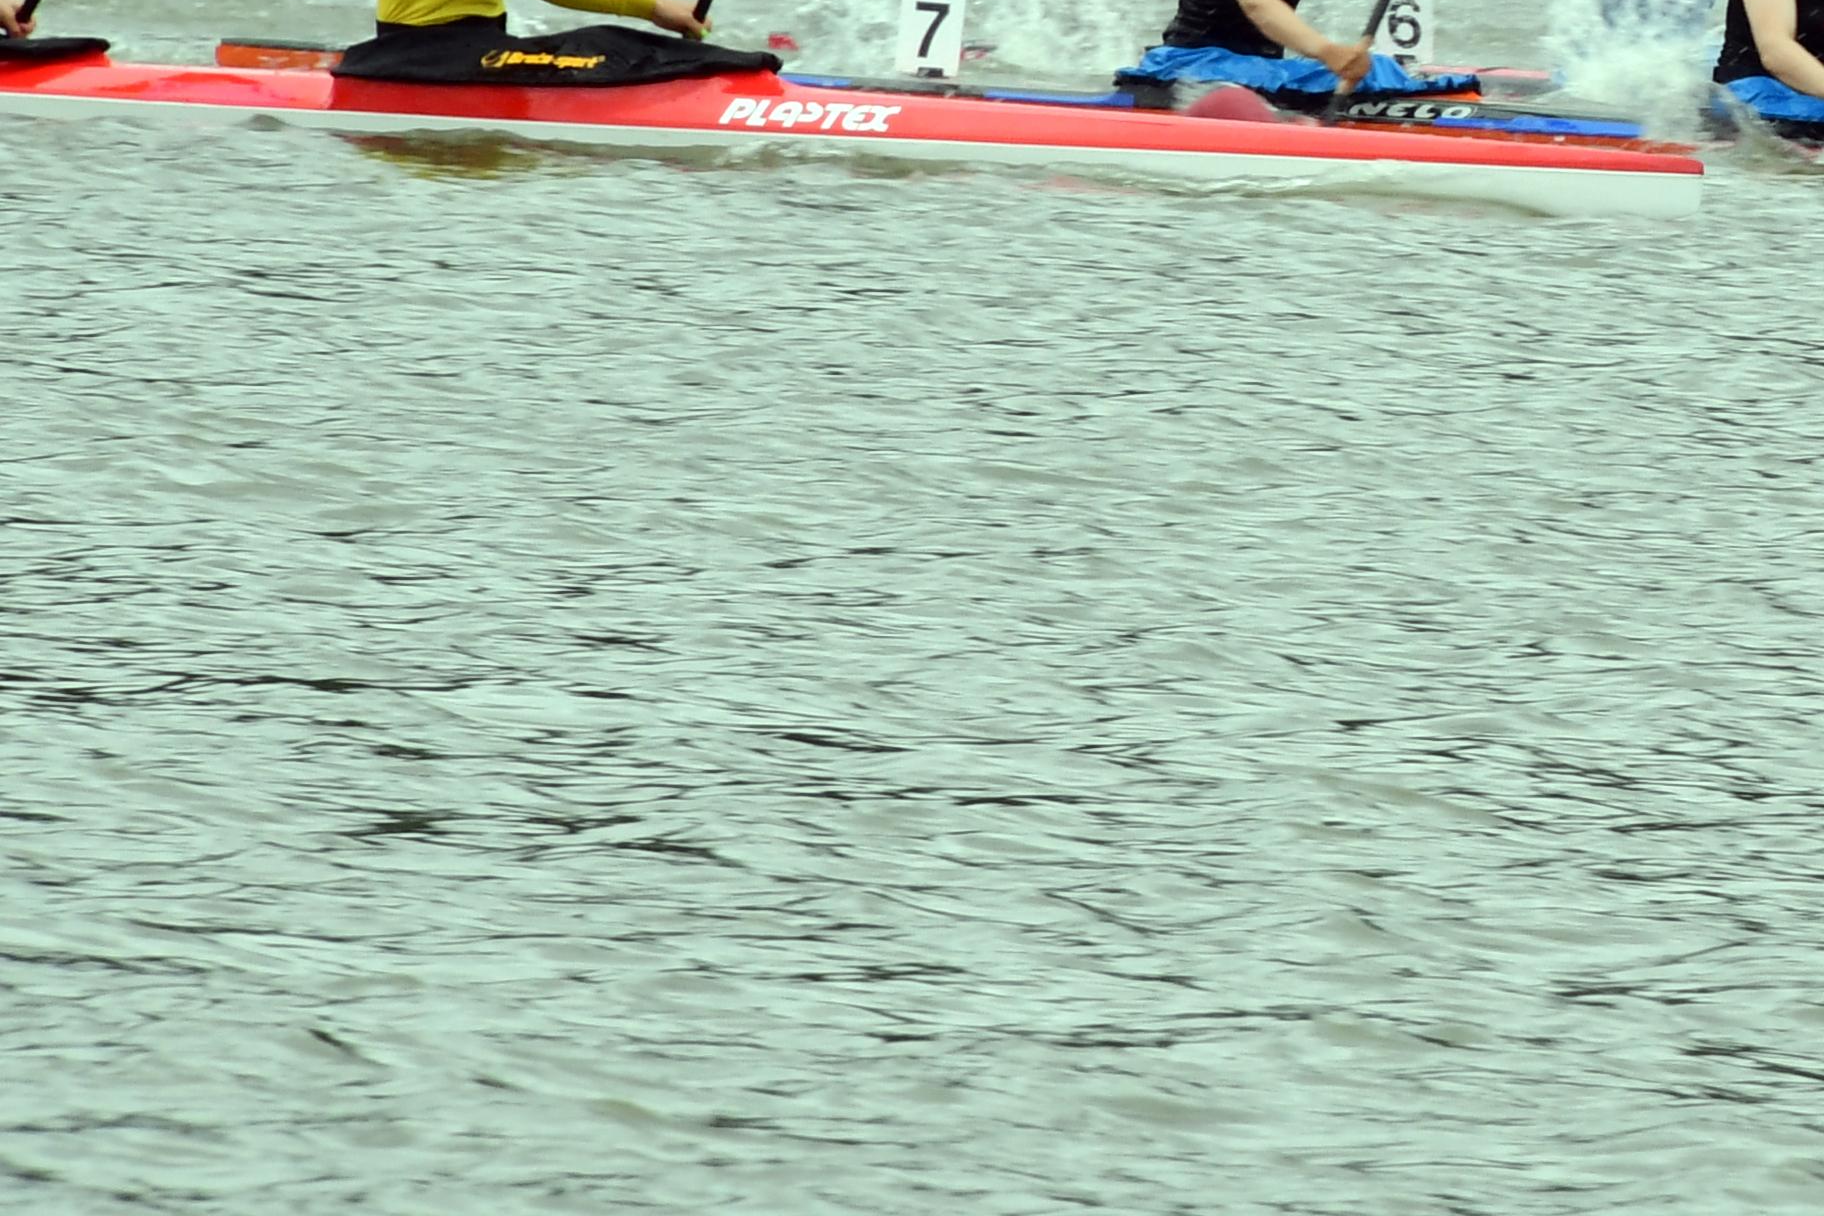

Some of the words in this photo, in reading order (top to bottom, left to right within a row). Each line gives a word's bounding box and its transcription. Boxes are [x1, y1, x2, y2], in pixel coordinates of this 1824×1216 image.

[916, 1, 950, 58] 7
[718, 97, 902, 132] PLASTEX
[1348, 101, 1473, 120] NELO
